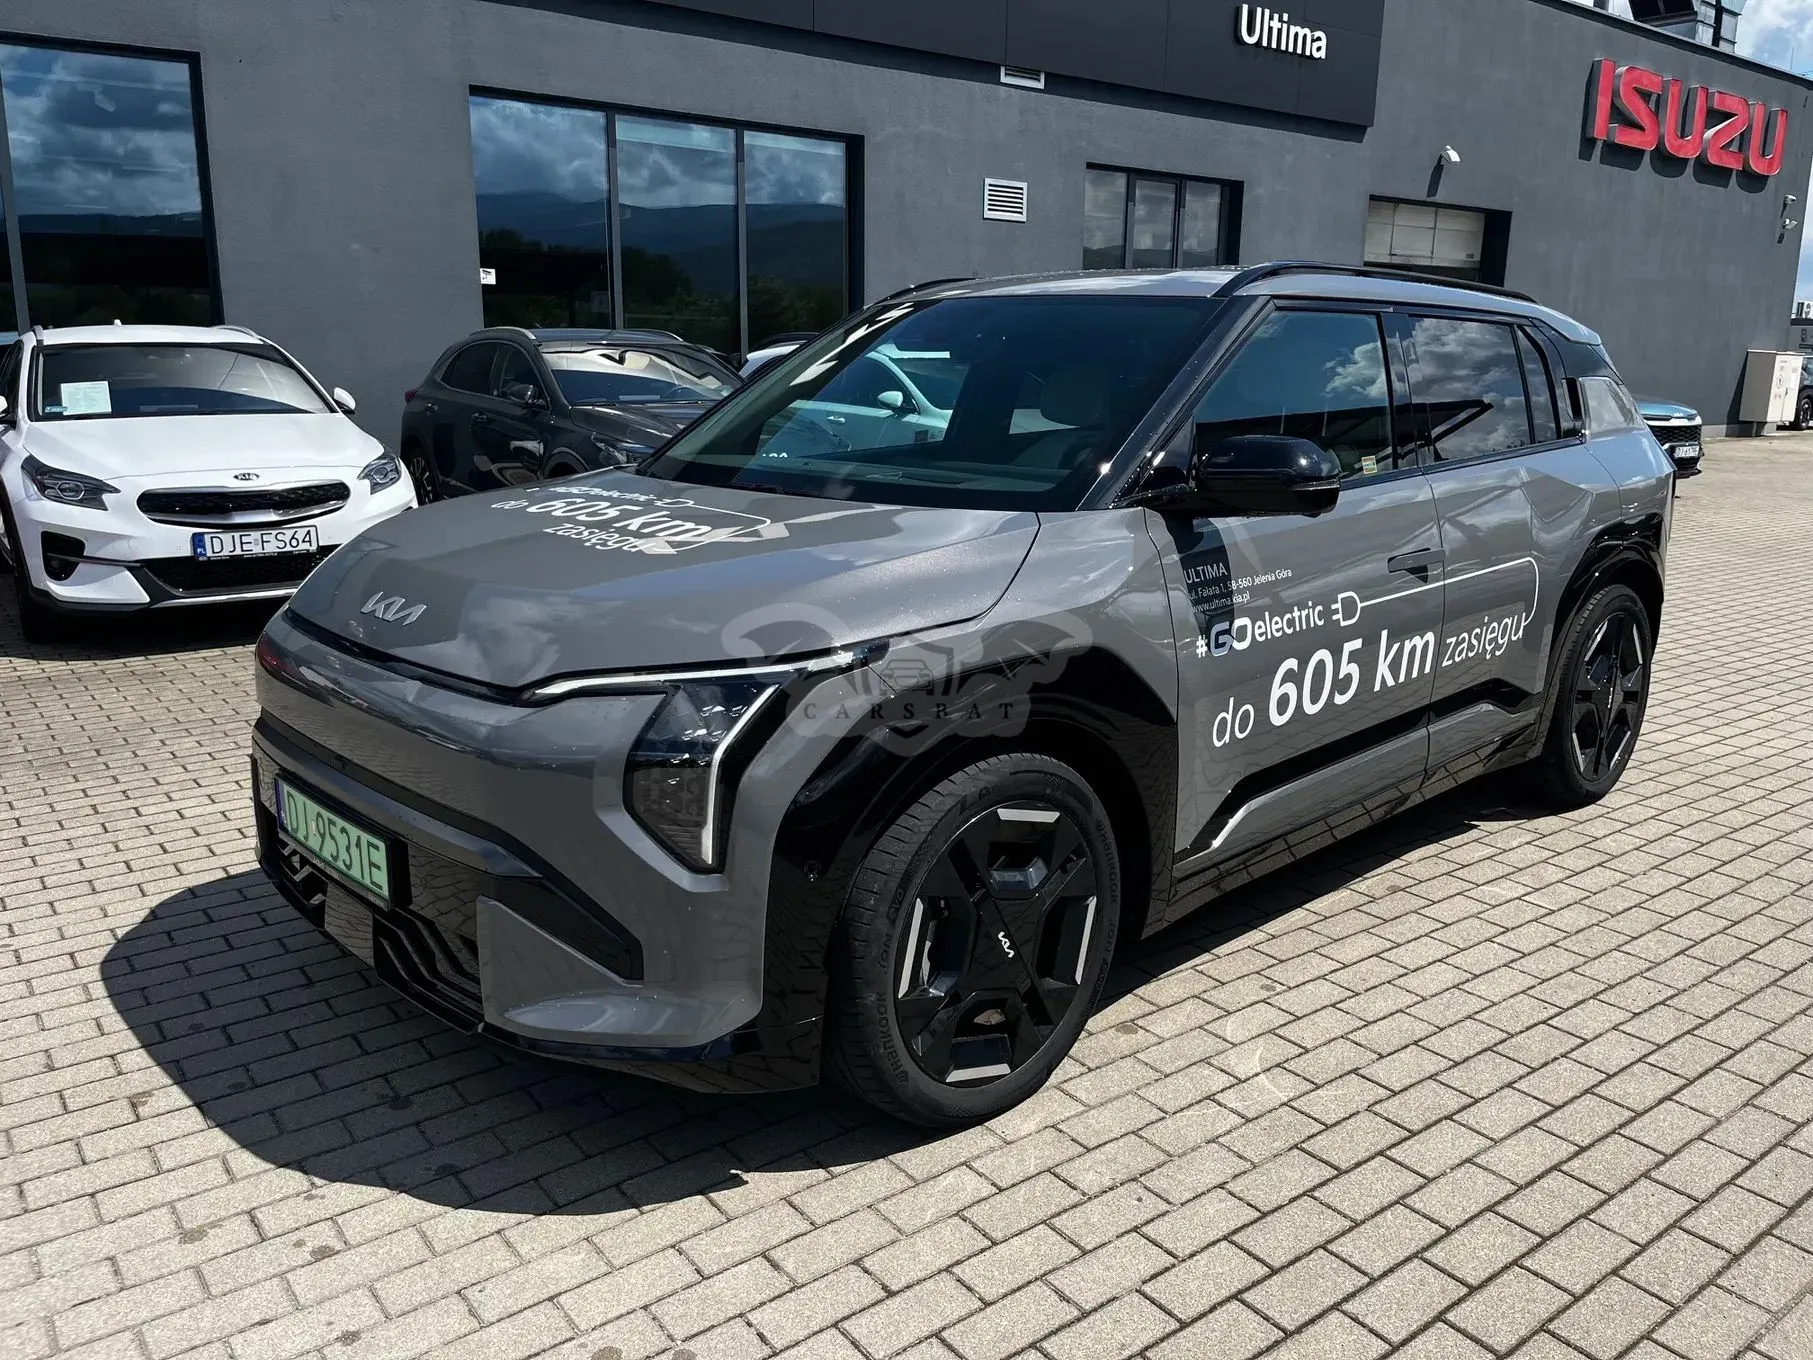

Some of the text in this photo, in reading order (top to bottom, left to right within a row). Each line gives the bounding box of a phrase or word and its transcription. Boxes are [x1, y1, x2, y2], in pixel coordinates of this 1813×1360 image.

[1237, 3, 1328, 61] Ultima
[1591, 56, 1788, 178] ISUZU
[209, 528, 313, 555] DJE FS64
[490, 497, 714, 542] do 605 km
[542, 521, 652, 553] zasięgu
[1183, 562, 1228, 584] ULTIMA
[1227, 576, 1253, 591] 58-560
[1253, 571, 1276, 586] Jelenia
[1275, 567, 1293, 580] Góra
[1211, 611, 1526, 748] do 605 km zasięgu
[286, 789, 309, 845] DJ
[316, 810, 385, 892] 9531E
